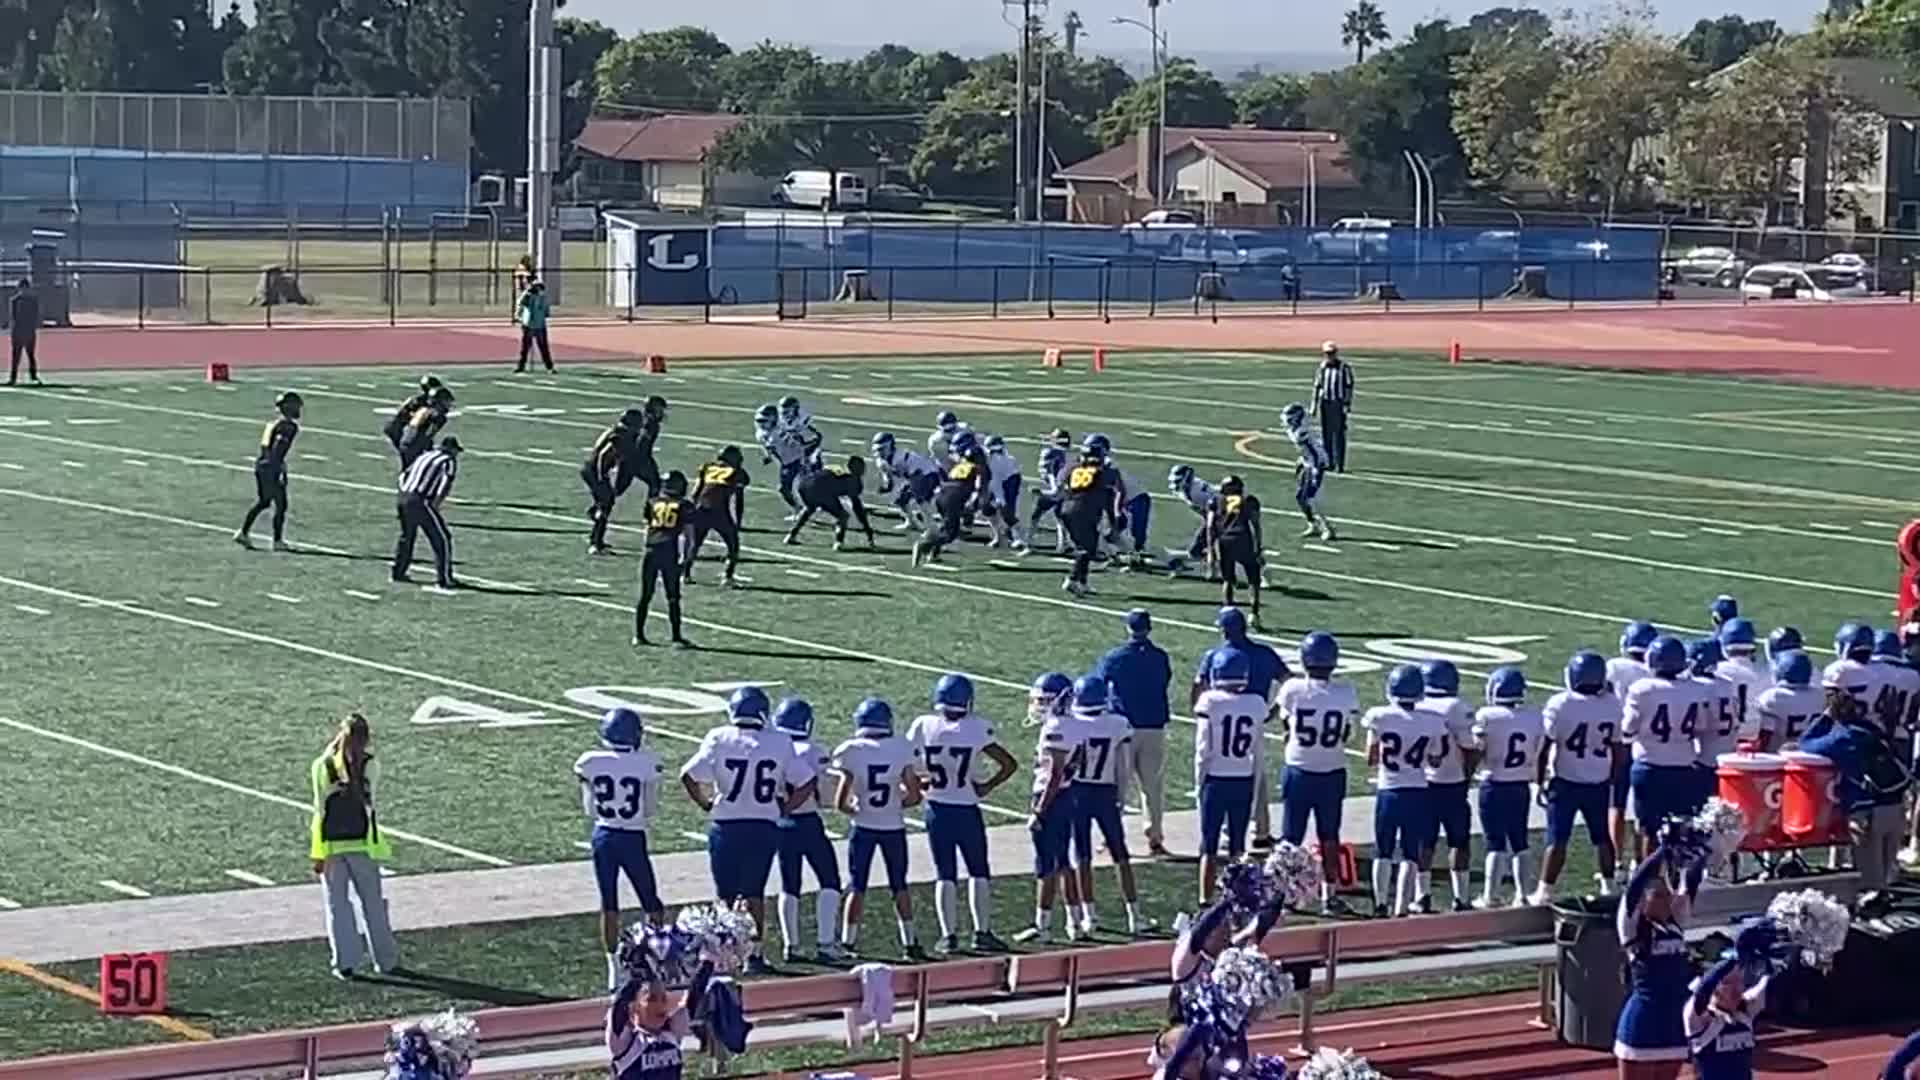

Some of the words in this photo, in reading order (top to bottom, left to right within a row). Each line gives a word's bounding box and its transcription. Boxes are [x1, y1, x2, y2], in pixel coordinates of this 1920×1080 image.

[702, 465, 735, 486] 22
[1221, 714, 1252, 759] 16
[1297, 709, 1340, 749] 58
[1565, 722, 1615, 759] 43
[1650, 702, 1699, 744] 44
[924, 744, 973, 790] 57
[1381, 732, 1430, 772] 24
[1504, 732, 1527, 768] 6
[592, 774, 642, 820] 23
[724, 759, 777, 804] 76
[867, 764, 891, 807] 5
[108, 958, 158, 1008] 50
